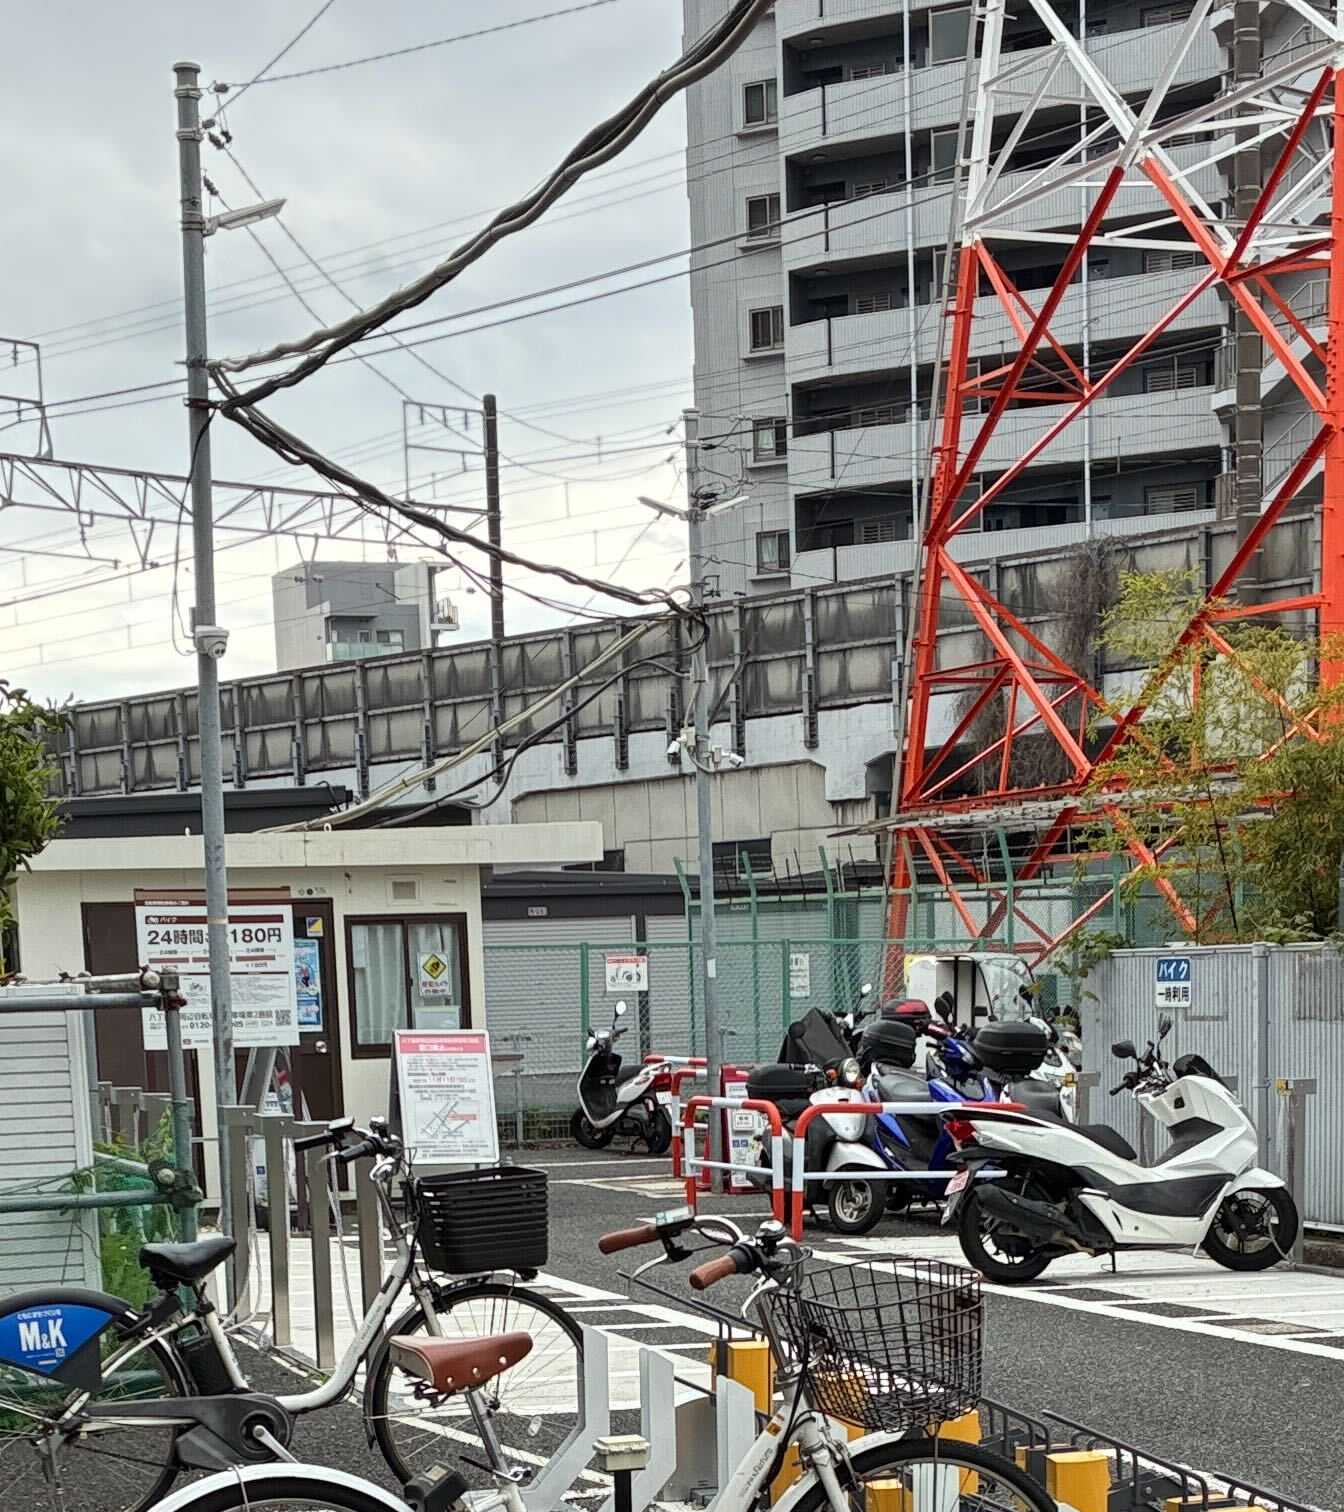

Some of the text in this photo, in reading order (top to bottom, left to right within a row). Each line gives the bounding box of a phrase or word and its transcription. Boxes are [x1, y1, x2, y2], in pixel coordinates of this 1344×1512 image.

[1158, 960, 1188, 979] バイク
[1157, 985, 1190, 1002] 一時利用
[18, 1318, 68, 1352] M&K
